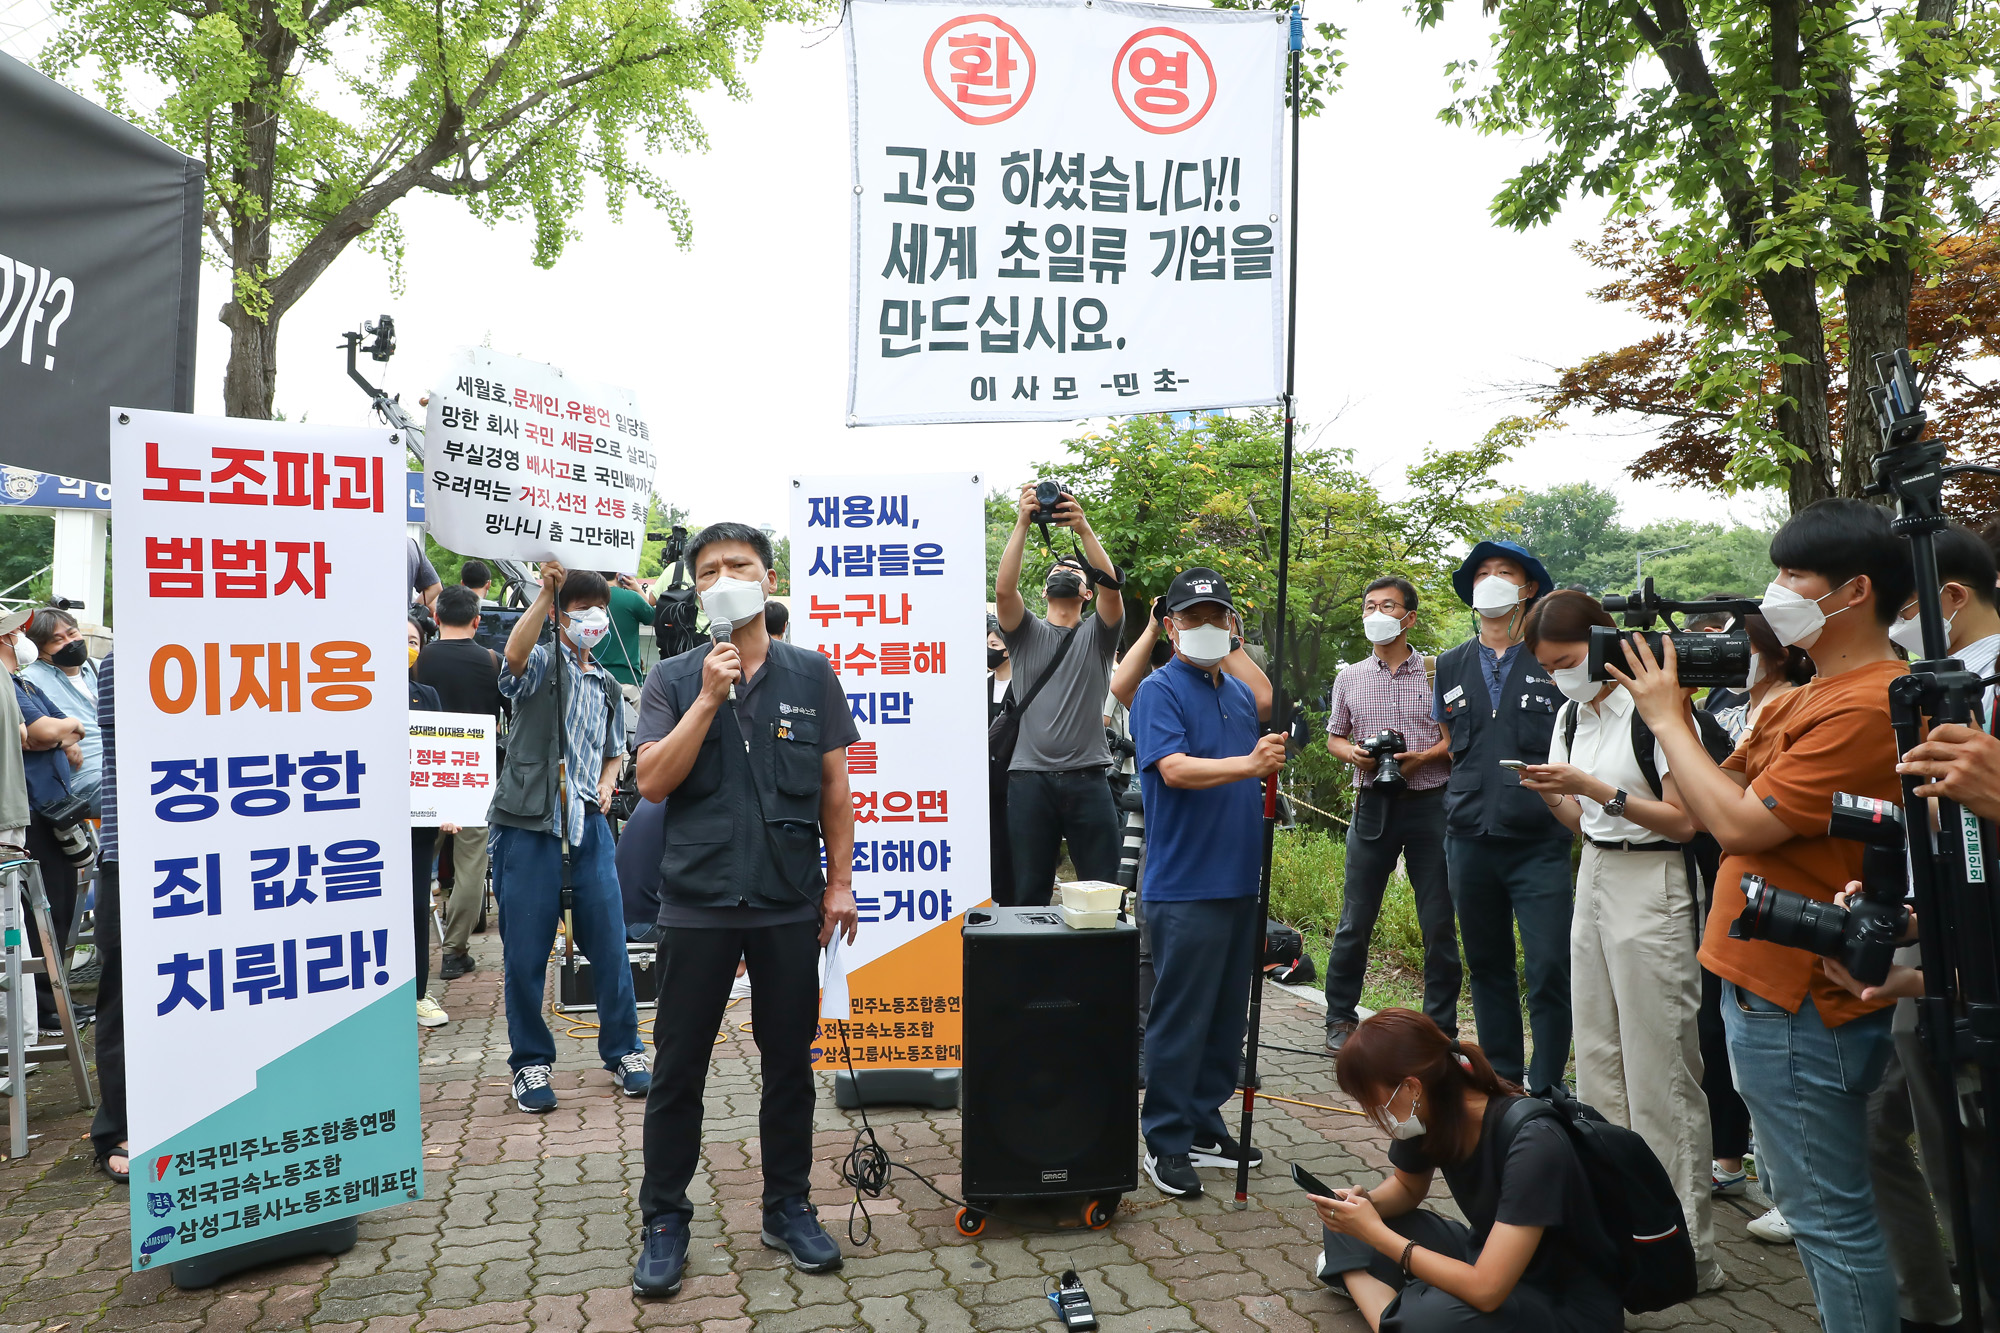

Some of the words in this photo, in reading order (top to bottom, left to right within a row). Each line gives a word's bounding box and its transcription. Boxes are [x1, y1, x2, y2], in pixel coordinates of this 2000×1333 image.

[948, 33, 1017, 106] 환
[1129, 47, 1189, 114] 영
[884, 146, 976, 211] 고생
[1001, 149, 1240, 216] 하셨습니다!!
[882, 223, 977, 284] 세계
[998, 221, 1127, 284] 초일류
[1150, 224, 1274, 281] 기업을
[880, 296, 1126, 358] 만드십시요.
[441, 405, 479, 431] 망한
[487, 413, 519, 439] 회사
[524, 422, 554, 447] 국민
[561, 430, 623, 459] 세금으로
[626, 444, 657, 470] 살리고
[615, 413, 649, 441] 일당들
[143, 442, 383, 513] 노조파괴
[443, 440, 520, 471] 부실경영
[527, 455, 587, 482] 배사고로
[432, 470, 511, 502] 우려먹는
[595, 496, 626, 519] 선동
[808, 495, 919, 529] 재용씨,
[485, 513, 542, 539] 망나니
[549, 521, 563, 542] 춤
[570, 525, 635, 549] 그만해라
[146, 537, 331, 599] 범법자
[809, 543, 945, 577] 사람들은
[809, 593, 912, 627] 누구나
[149, 641, 375, 715] 이재용
[438, 727, 465, 738] 이재용
[467, 728, 485, 738] 석방
[417, 750, 446, 765] 정부
[451, 751, 480, 766] 규탄
[462, 772, 489, 788] 촉구
[151, 750, 366, 822] 정당한
[851, 790, 948, 823] 었으면
[153, 853, 221, 919] 죄
[250, 839, 384, 910] 값을
[820, 840, 951, 873] 죄해야
[157, 929, 389, 1016] 치뤄라!
[850, 996, 960, 1014] 민주노동조합총연
[824, 1021, 934, 1039] 전국금속노동조합
[174, 1109, 397, 1176] 전국민주노동조합총연맹
[176, 1167, 418, 1245] 삼성그룹사노동조합대표단
[177, 1154, 342, 1211] 전국금속노동조합
[145, 1233, 172, 1248] SAMSUNG
